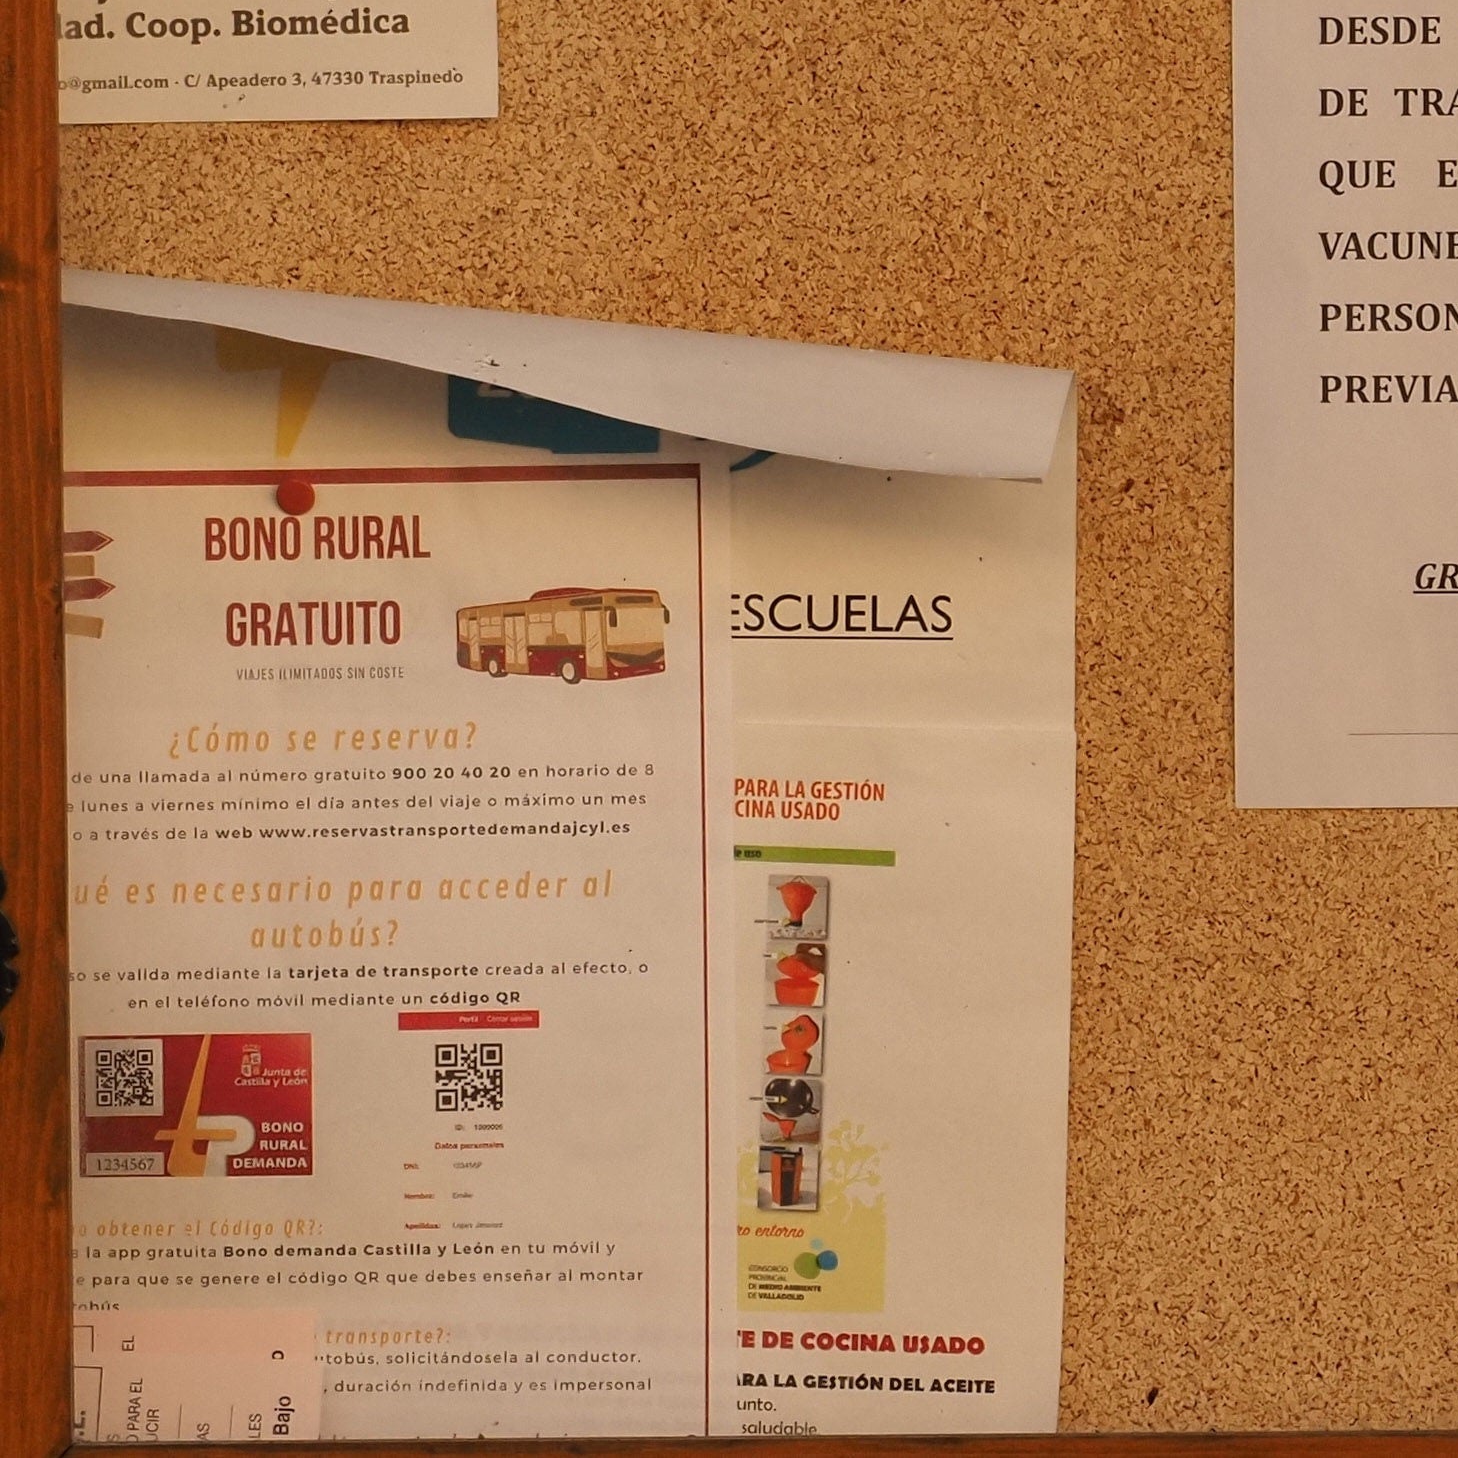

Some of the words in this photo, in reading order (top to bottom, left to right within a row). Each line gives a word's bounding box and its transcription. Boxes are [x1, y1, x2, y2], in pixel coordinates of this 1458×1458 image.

[184, 74, 201, 88] C/
[207, 73, 287, 90] Apeadero
[292, 72, 306, 87] 3,
[311, 71, 364, 85] 47330
[369, 69, 463, 88] Traspinedo
[205, 515, 301, 561] BONO
[314, 515, 431, 560] RURAL
[226, 600, 400, 647] GRATUITO
[168, 723, 269, 759] ¿Cómo
[287, 730, 317, 752] se
[334, 721, 477, 751] reserva?
[97, 1158, 155, 1173] 1234567
[774, 1374, 797, 1388] LA
[803, 1374, 883, 1390] GESTIÓN
[889, 1377, 924, 1391] DEL
[930, 1379, 995, 1393] ACEITE
